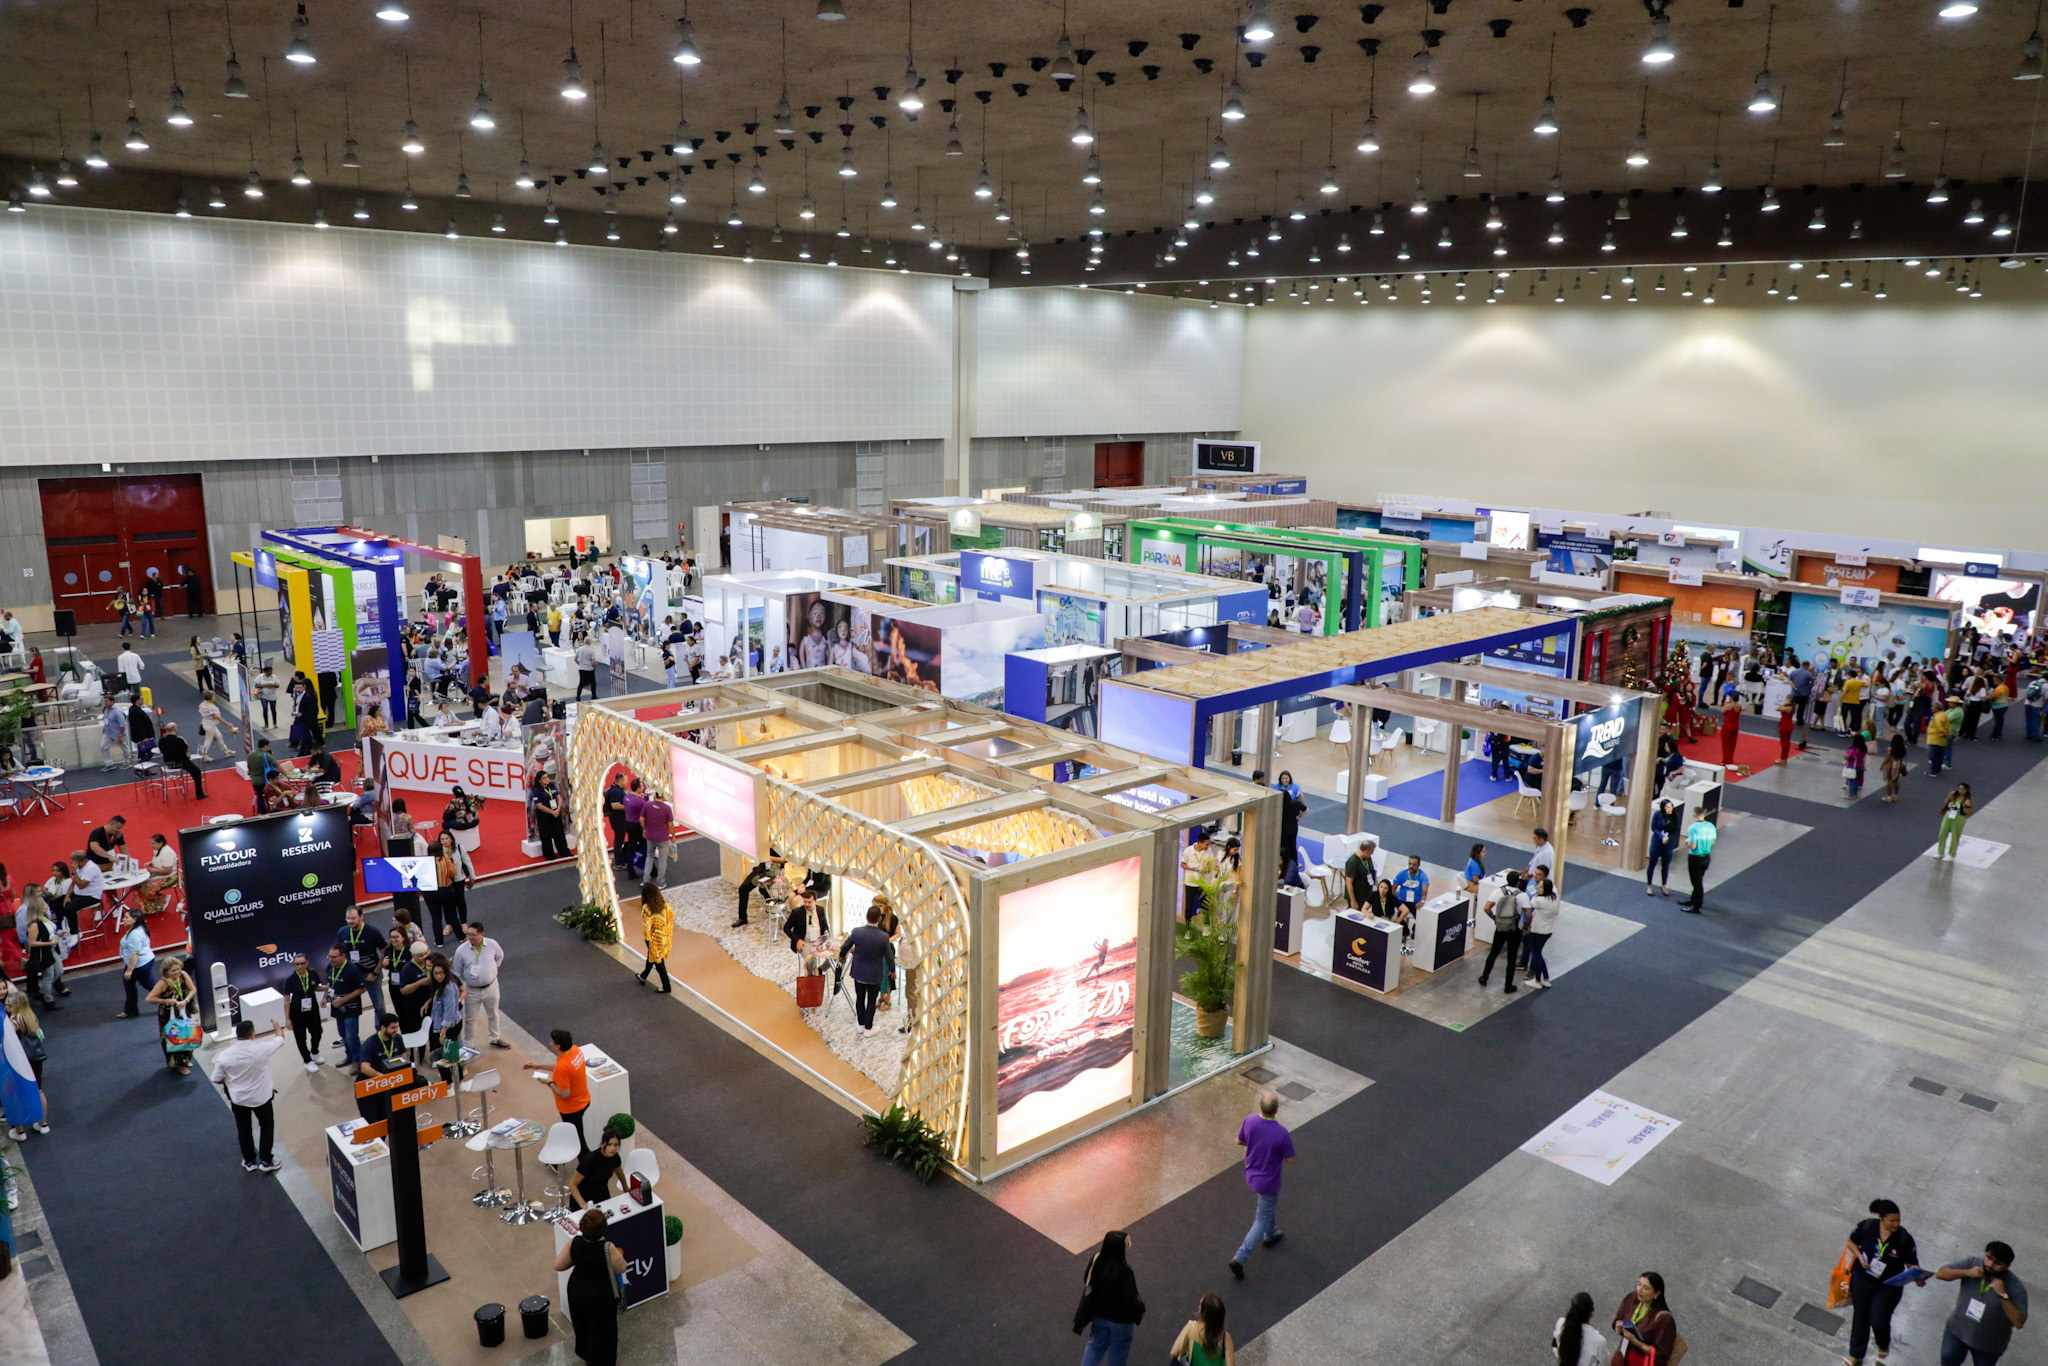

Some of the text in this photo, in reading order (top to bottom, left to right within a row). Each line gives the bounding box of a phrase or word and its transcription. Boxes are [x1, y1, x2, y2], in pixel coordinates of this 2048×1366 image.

[1220, 450, 1235, 461] VB
[1396, 510, 1414, 518] Uruguay
[1664, 533, 1676, 542] G7
[1144, 550, 1182, 567] PARANÁ
[1670, 557, 1680, 566] G7
[1846, 593, 1874, 601] SEBRAE
[1590, 717, 1625, 743] TREND
[1604, 738, 1620, 750] VIAGENS
[1136, 788, 1158, 801] está
[1158, 796, 1172, 806] no
[281, 840, 332, 858] RESERVIA
[200, 848, 258, 867] FLYTOUR
[208, 860, 252, 872] consolidadora
[278, 883, 344, 905] QUEENSBERRY
[301, 896, 322, 906] viagens
[204, 900, 264, 921] QUALITOURS
[216, 914, 235, 924] cruises
[240, 911, 254, 920] tours
[1446, 923, 1463, 936] TREND
[258, 951, 297, 969] BeFly
[1346, 952, 1370, 966] Comfort
[1346, 962, 1371, 975] FORTALEZA
[365, 1073, 404, 1093] Praça
[401, 1086, 438, 1105] BeFly
[1586, 1109, 1615, 1129] BRASIL
[1628, 1125, 1656, 1145] BRASIL
